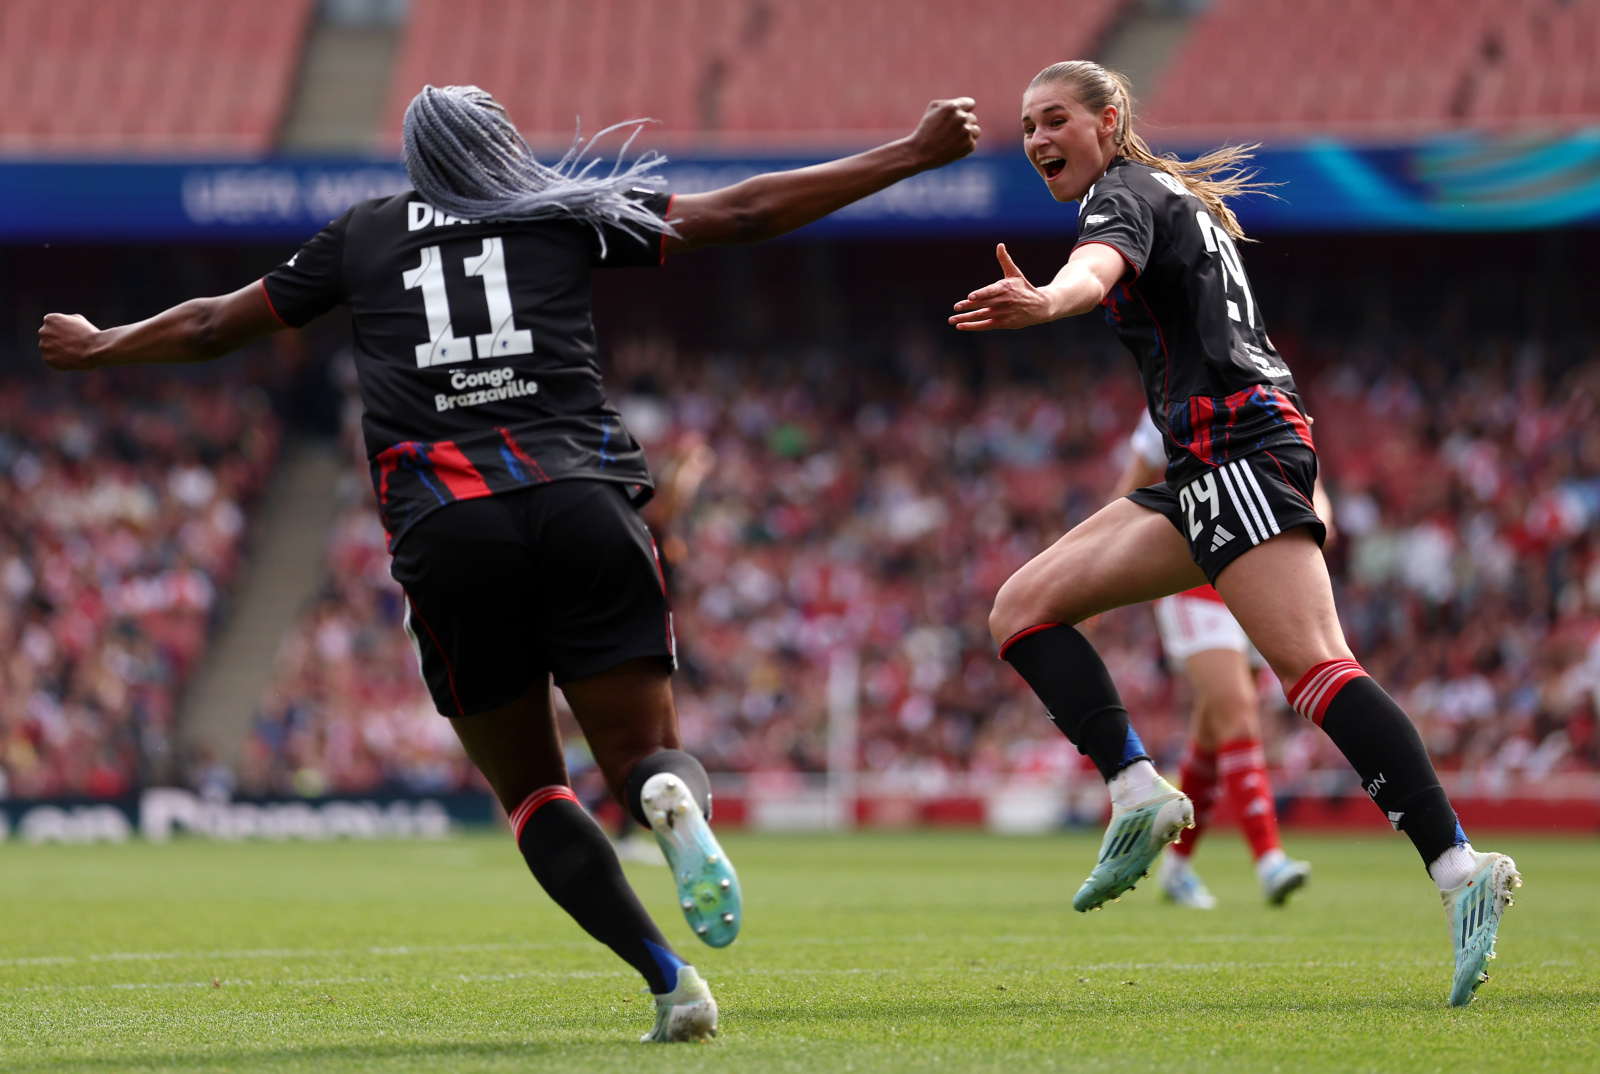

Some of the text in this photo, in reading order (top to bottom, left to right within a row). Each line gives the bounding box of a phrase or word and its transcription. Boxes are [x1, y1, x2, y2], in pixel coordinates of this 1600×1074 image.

[402, 236, 534, 369] 11
[434, 378, 538, 412] Brazzaville
[451, 366, 514, 390] Congo
